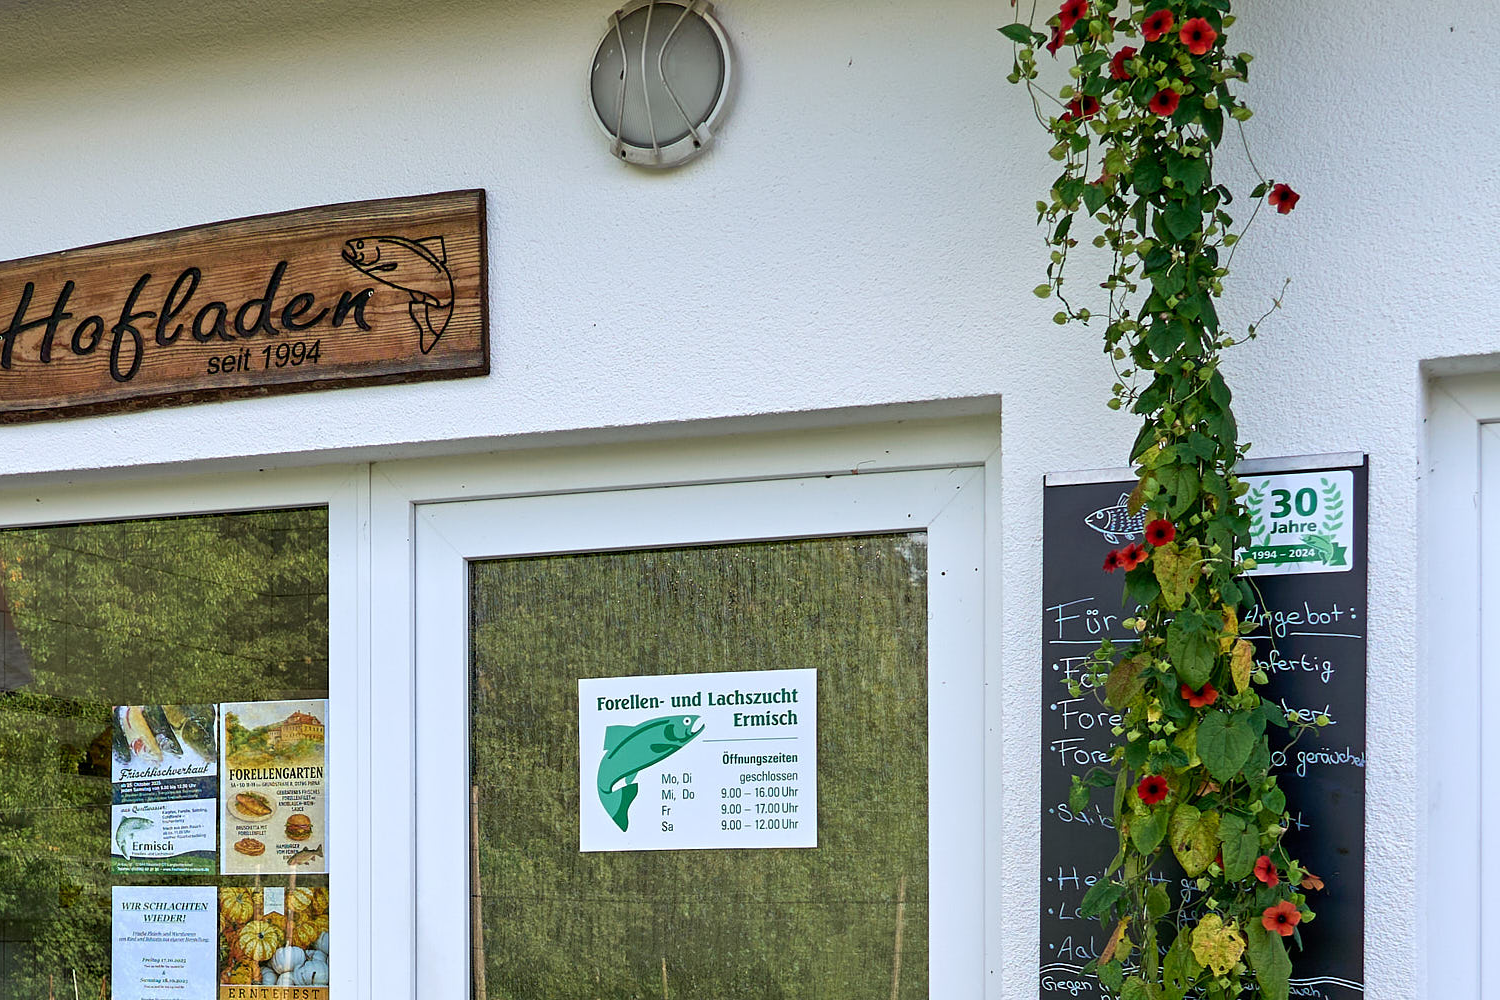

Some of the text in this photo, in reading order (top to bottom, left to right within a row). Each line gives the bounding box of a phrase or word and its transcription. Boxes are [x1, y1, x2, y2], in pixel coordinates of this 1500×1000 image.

[0, 261, 373, 383] Hofladen
[206, 339, 322, 376] seit 1994
[1270, 487, 1318, 518] 30
[1270, 520, 1317, 534] Jahre
[1252, 550, 1277, 560] 1994
[1288, 548, 1315, 558] 2024
[1046, 597, 1117, 639] Für
[596, 688, 799, 711] Forellen- und Lachszucht
[733, 710, 798, 727] Ermisch
[722, 751, 798, 766] Öffnungszeiten
[229, 767, 324, 781] FORELLENGARTEN
[661, 770, 798, 785] Mo, Di geschlossen
[661, 789, 677, 801] Mi,
[682, 788, 695, 800] Do
[721, 788, 742, 799] 9.00
[755, 787, 780, 798] 16.00
[781, 786, 799, 798] Uhr
[661, 805, 671, 816] Fr
[721, 804, 742, 815] 9.00
[755, 803, 780, 814] 17.00
[781, 802, 799, 814] Uhr
[661, 821, 674, 832] Sa
[721, 820, 742, 831] 9.00
[755, 819, 780, 830] 12.00
[781, 818, 799, 830] Uhr
[132, 841, 174, 851] Ermisch
[122, 902, 209, 911] WIR SCHLACHTEN
[143, 914, 187, 922] WIEDER!
[1041, 975, 1093, 997] Gegen
[228, 988, 320, 1000] ERNTEFEST
